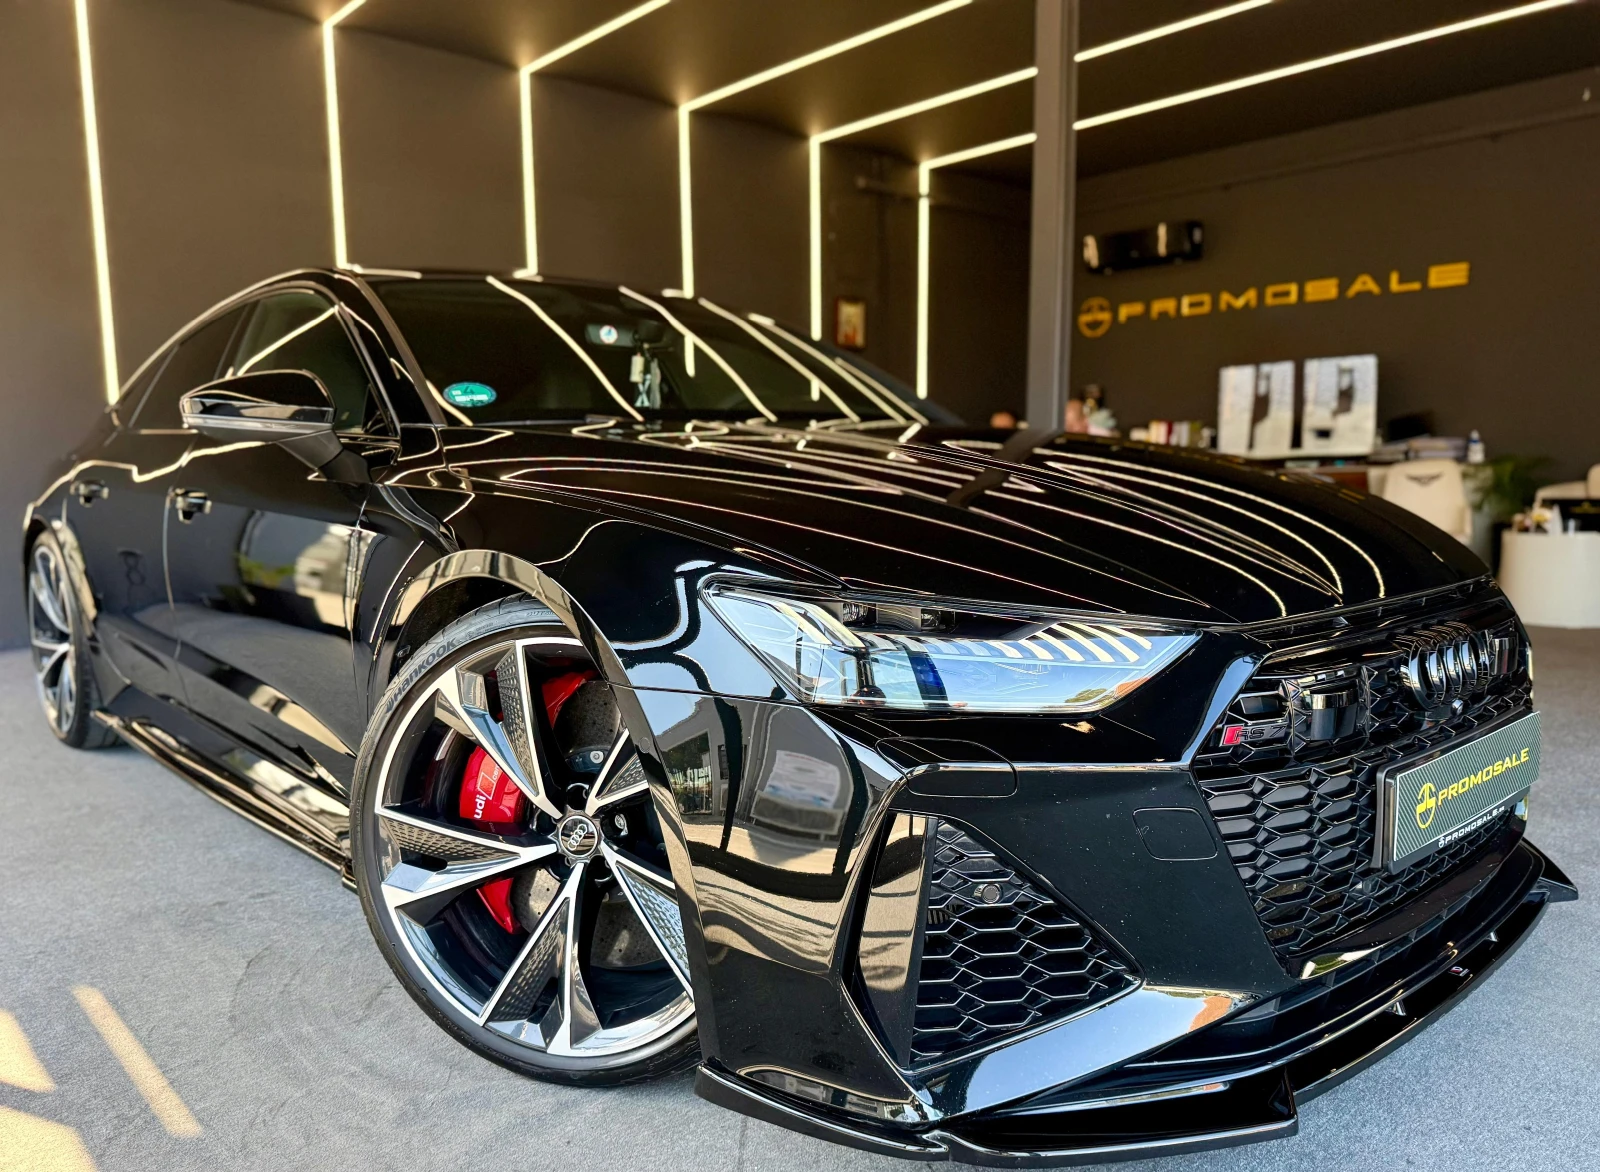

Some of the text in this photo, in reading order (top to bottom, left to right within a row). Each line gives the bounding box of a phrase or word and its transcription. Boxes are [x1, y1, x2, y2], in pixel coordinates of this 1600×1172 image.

[1117, 261, 1470, 324] PROMOSALE
[473, 794, 487, 819] udi
[1437, 747, 1530, 807] PROMOSALE
